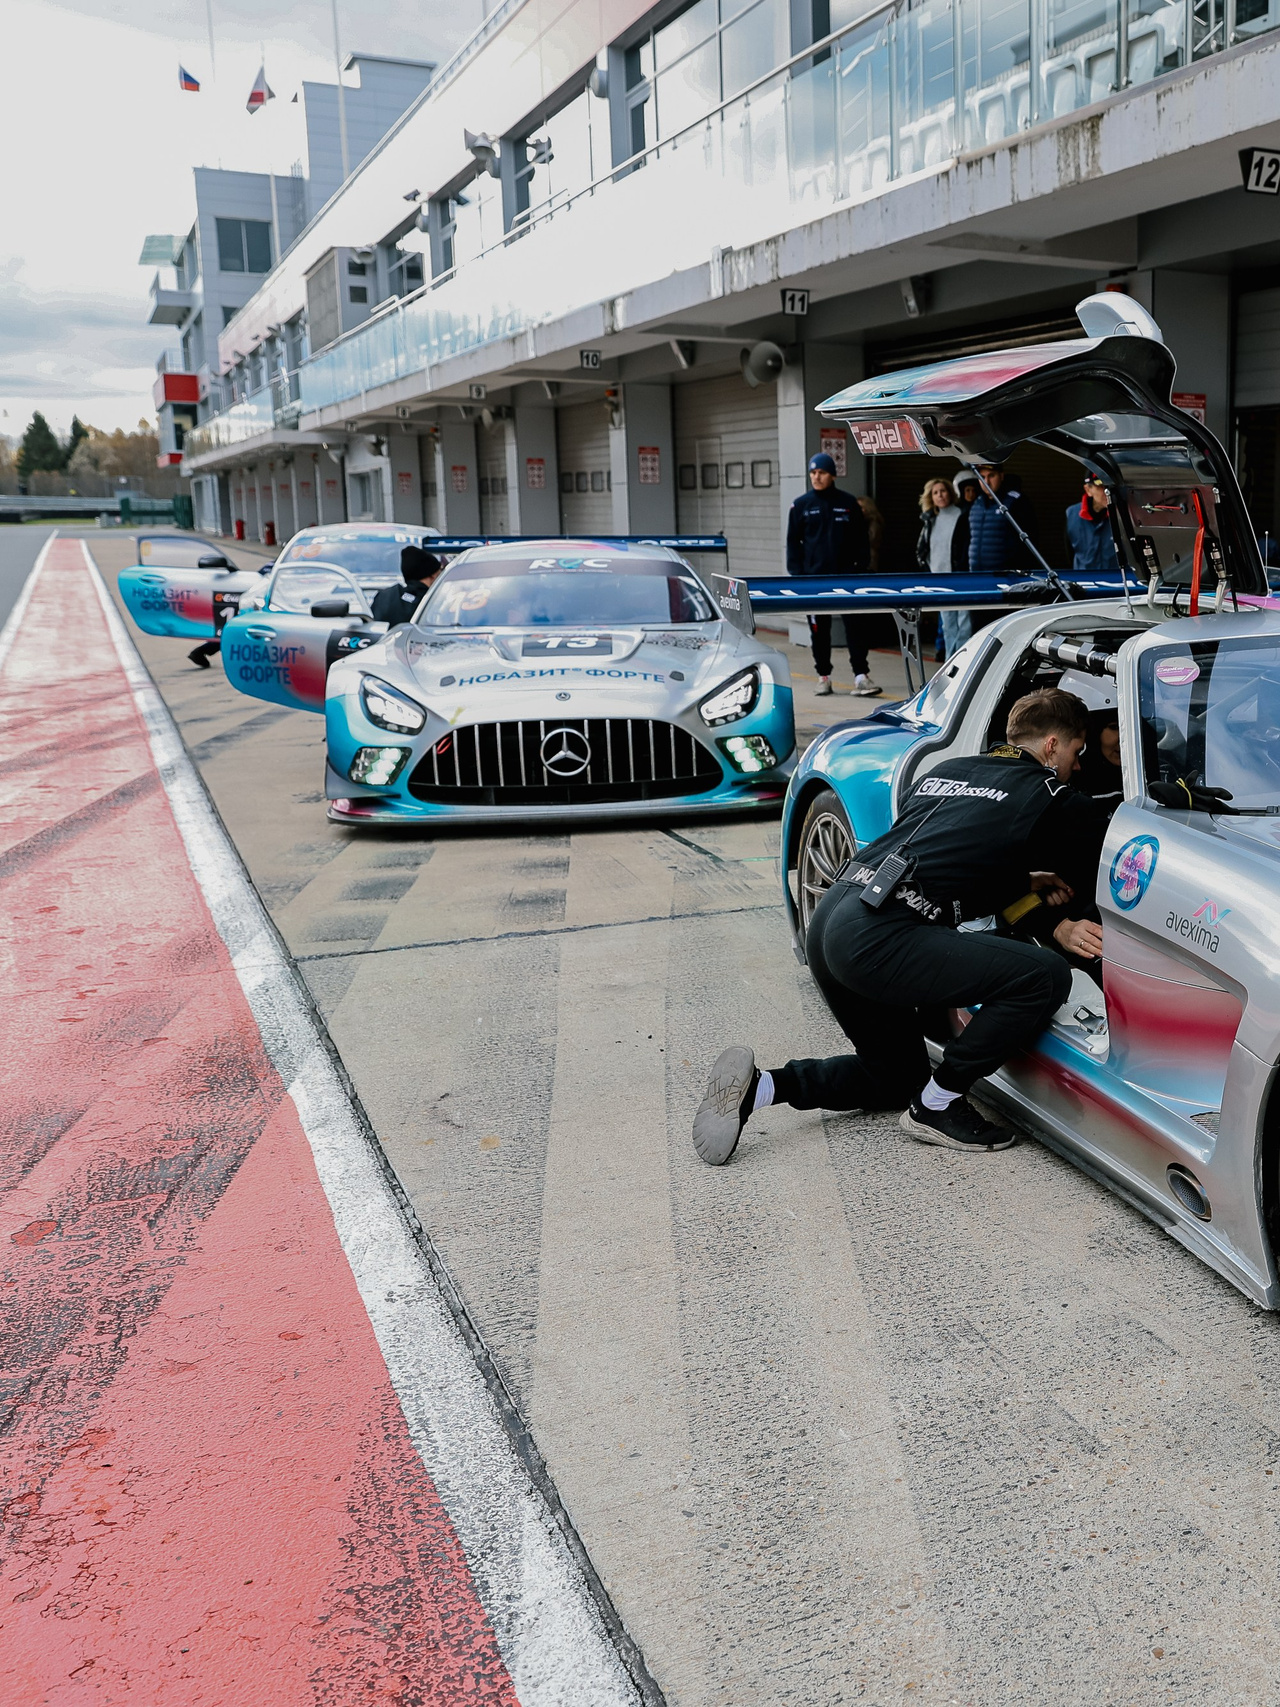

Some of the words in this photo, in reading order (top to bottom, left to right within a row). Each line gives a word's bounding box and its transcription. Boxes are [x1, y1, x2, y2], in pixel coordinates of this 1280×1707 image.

[1254, 156, 1280, 188] 12
[788, 293, 806, 312] 11
[584, 353, 598, 366] 10
[141, 600, 185, 612] ФОРТЕ
[720, 593, 740, 611] avexima
[538, 637, 598, 648] 13
[239, 665, 291, 685] ФОРТЕ
[585, 669, 665, 683] ФОРТЕ
[1165, 911, 1220, 953] avexima
